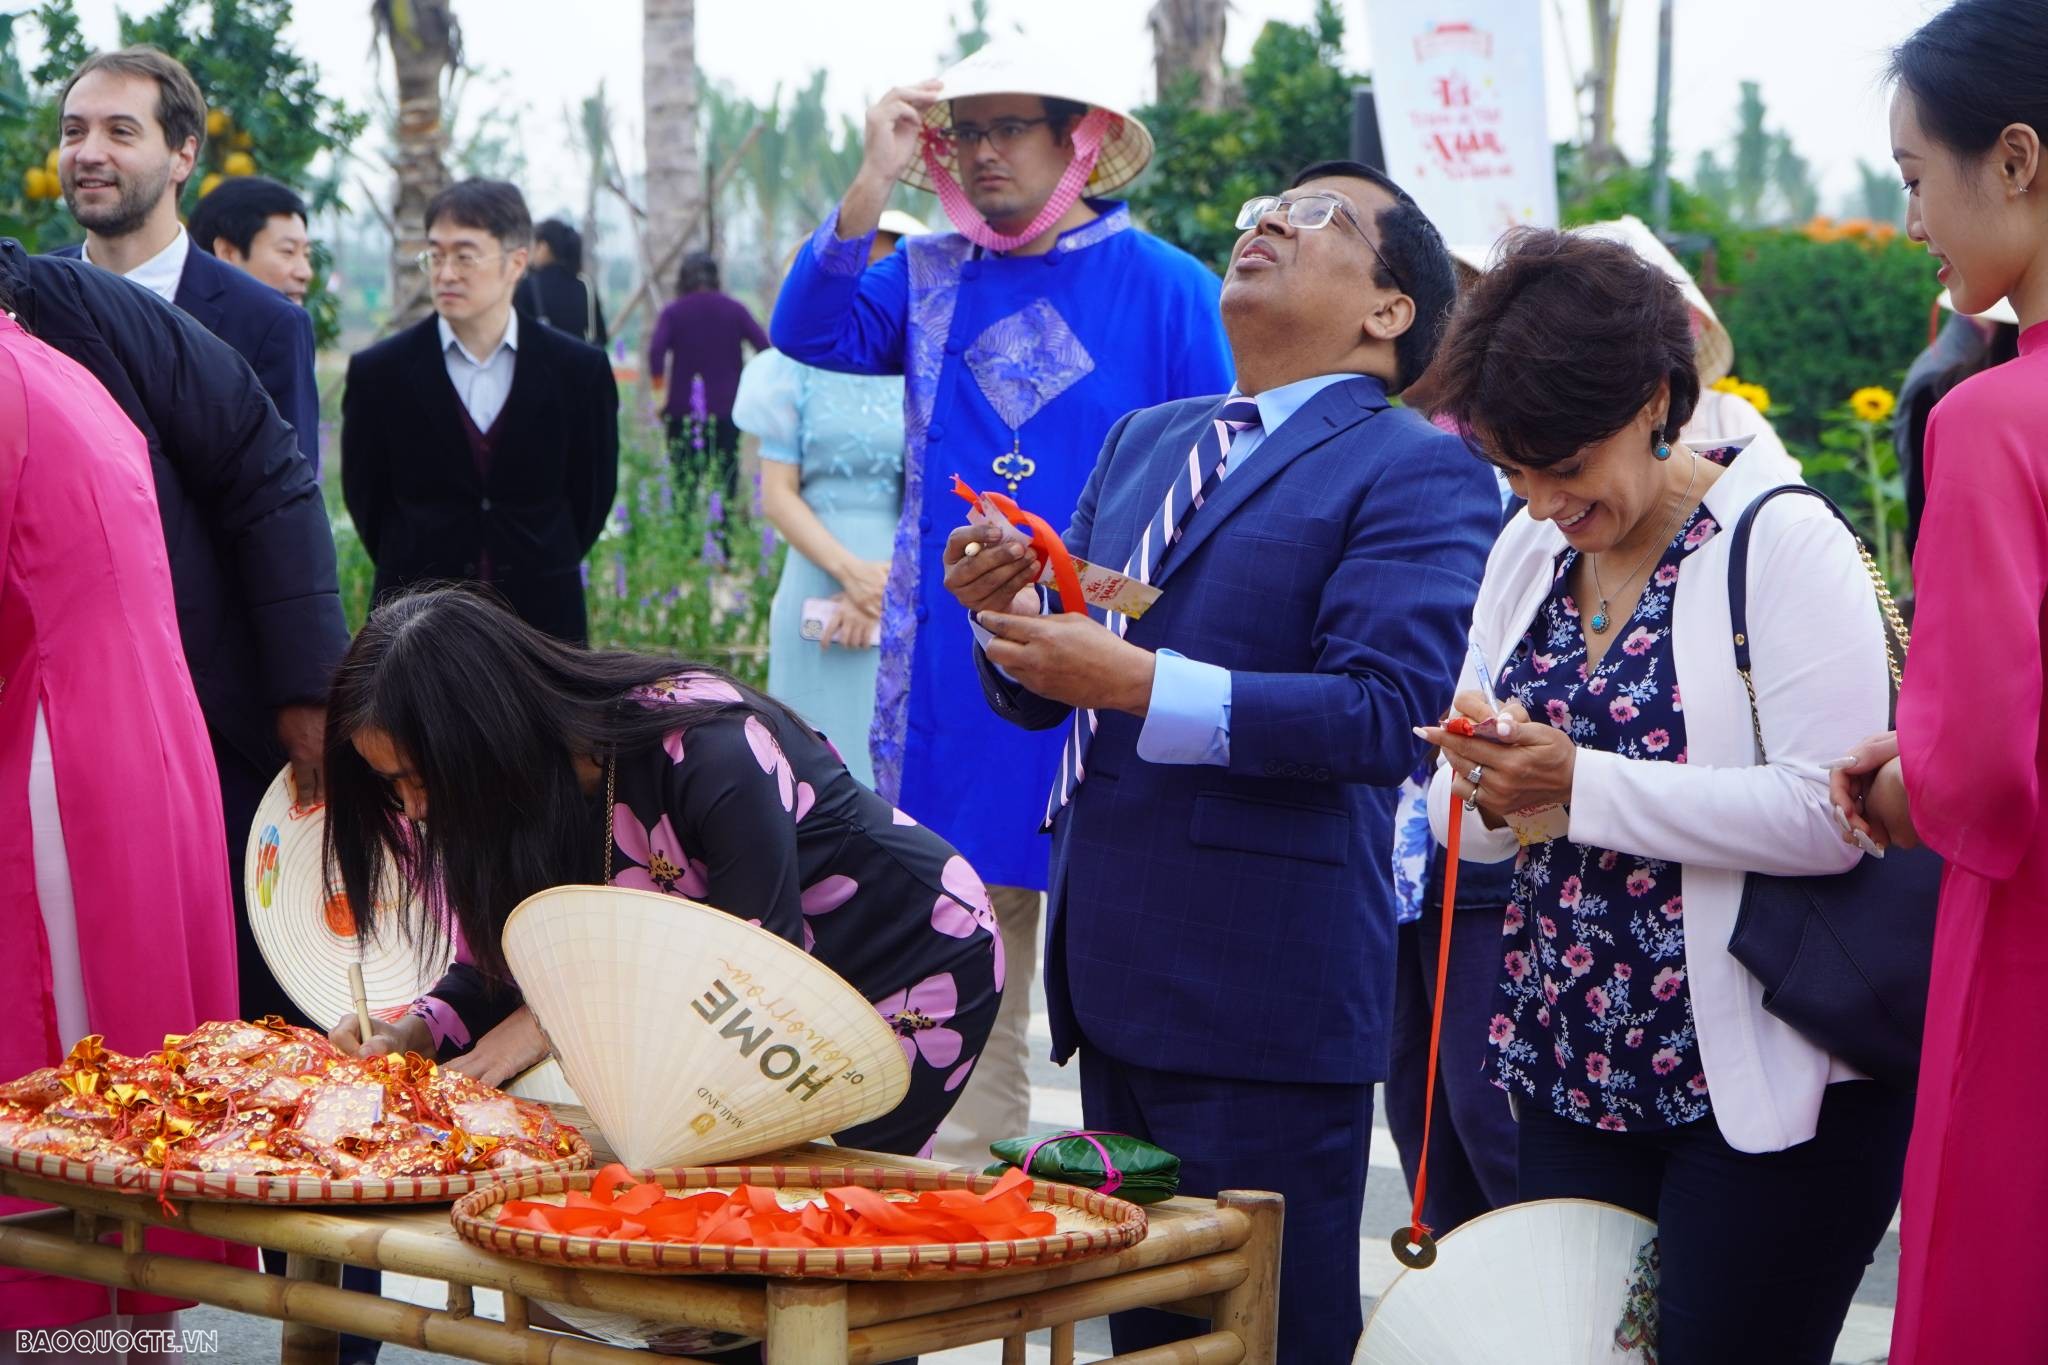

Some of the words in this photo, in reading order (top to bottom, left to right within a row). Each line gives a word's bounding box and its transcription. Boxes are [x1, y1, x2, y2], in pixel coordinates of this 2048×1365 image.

[690, 978, 834, 1102] HOME
[842, 1070, 864, 1085] OF
[697, 1087, 745, 1129] MAILAND
